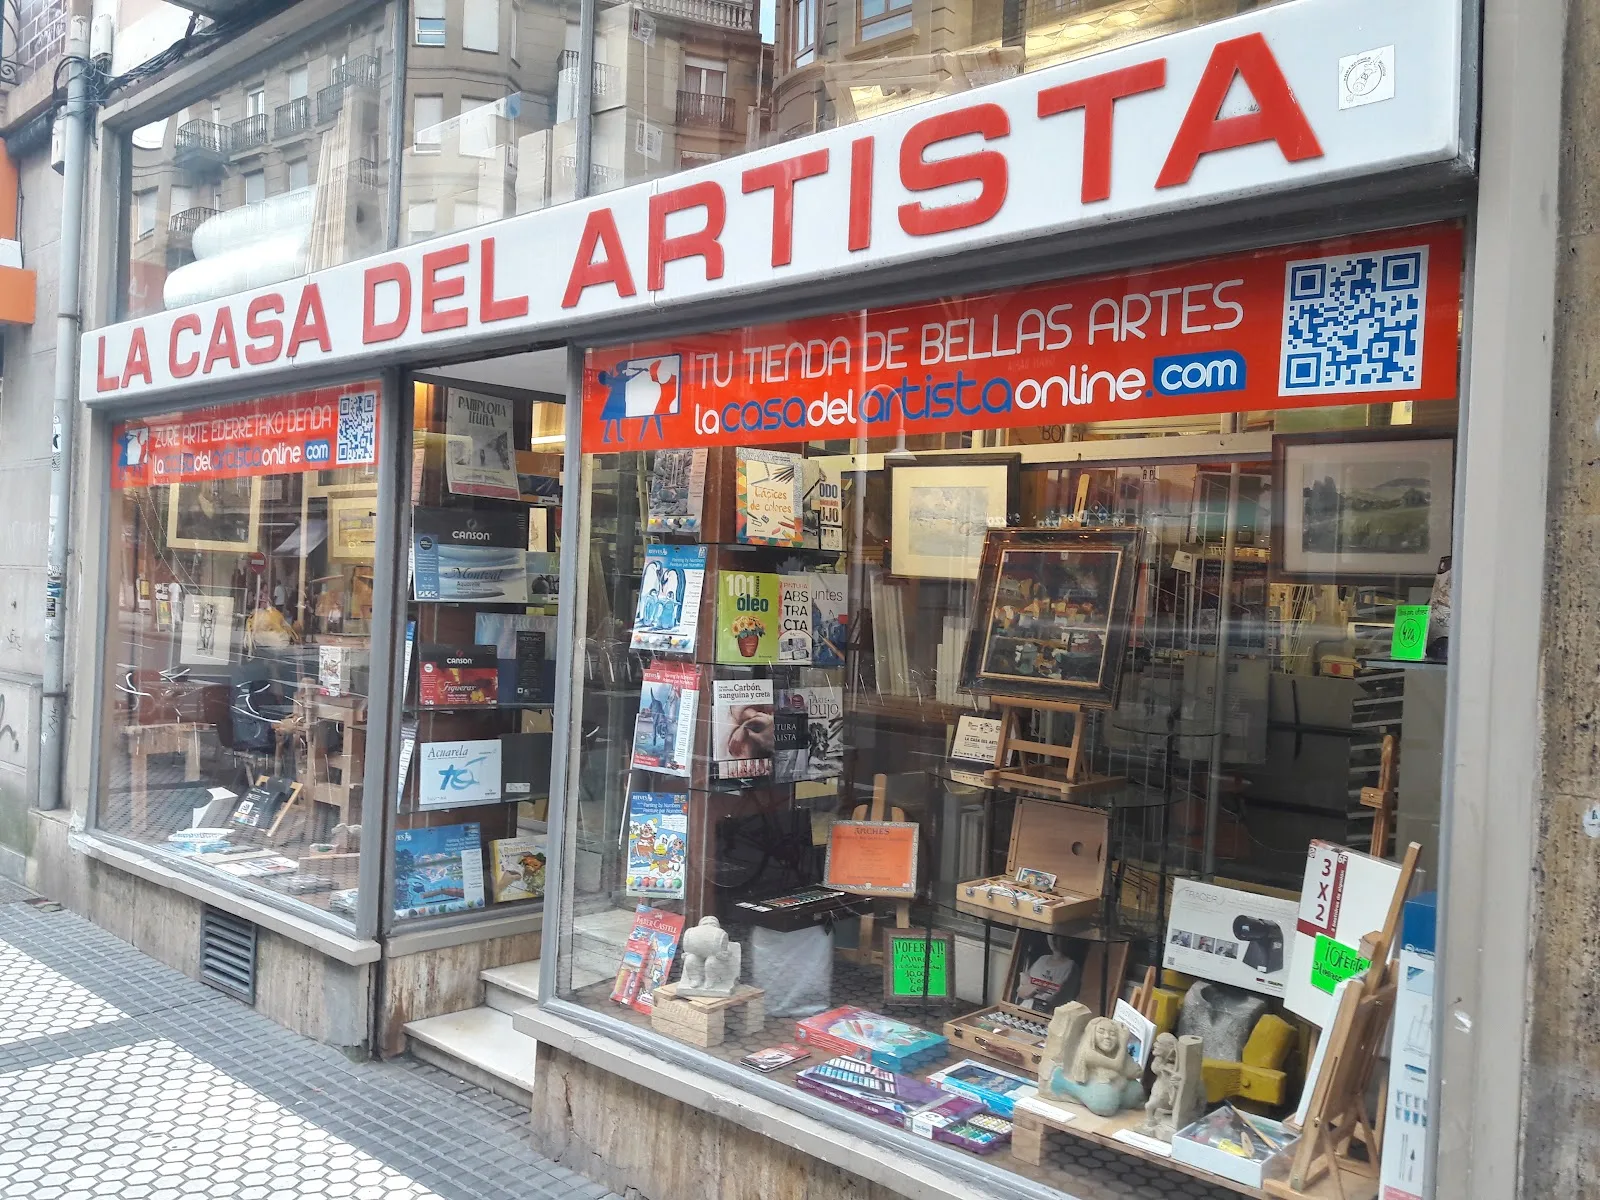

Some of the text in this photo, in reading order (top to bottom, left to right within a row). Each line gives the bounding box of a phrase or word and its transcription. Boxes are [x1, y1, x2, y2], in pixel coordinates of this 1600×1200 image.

[97, 32, 1325, 392] LA CASA DEL ARTISTA
[696, 279, 1244, 389] TU TIENDA DE BELLAS ARTES
[458, 396, 506, 417] PAMPLONA
[154, 405, 332, 448] ZURE ARTE EDERRETAKO DENDA
[750, 500, 792, 514] de colores
[452, 530, 490, 541] CANSON
[726, 574, 754, 598] 101
[737, 593, 769, 612] óleo
[784, 590, 808, 602] ABS
[784, 604, 808, 616] TRA
[783, 618, 808, 631] CTA
[442, 681, 477, 694] Figueras
[719, 691, 749, 701] sanguina
[428, 744, 469, 758] Acuarela
[855, 828, 890, 836] ARCHES
[1315, 858, 1332, 921] 3 X 2
